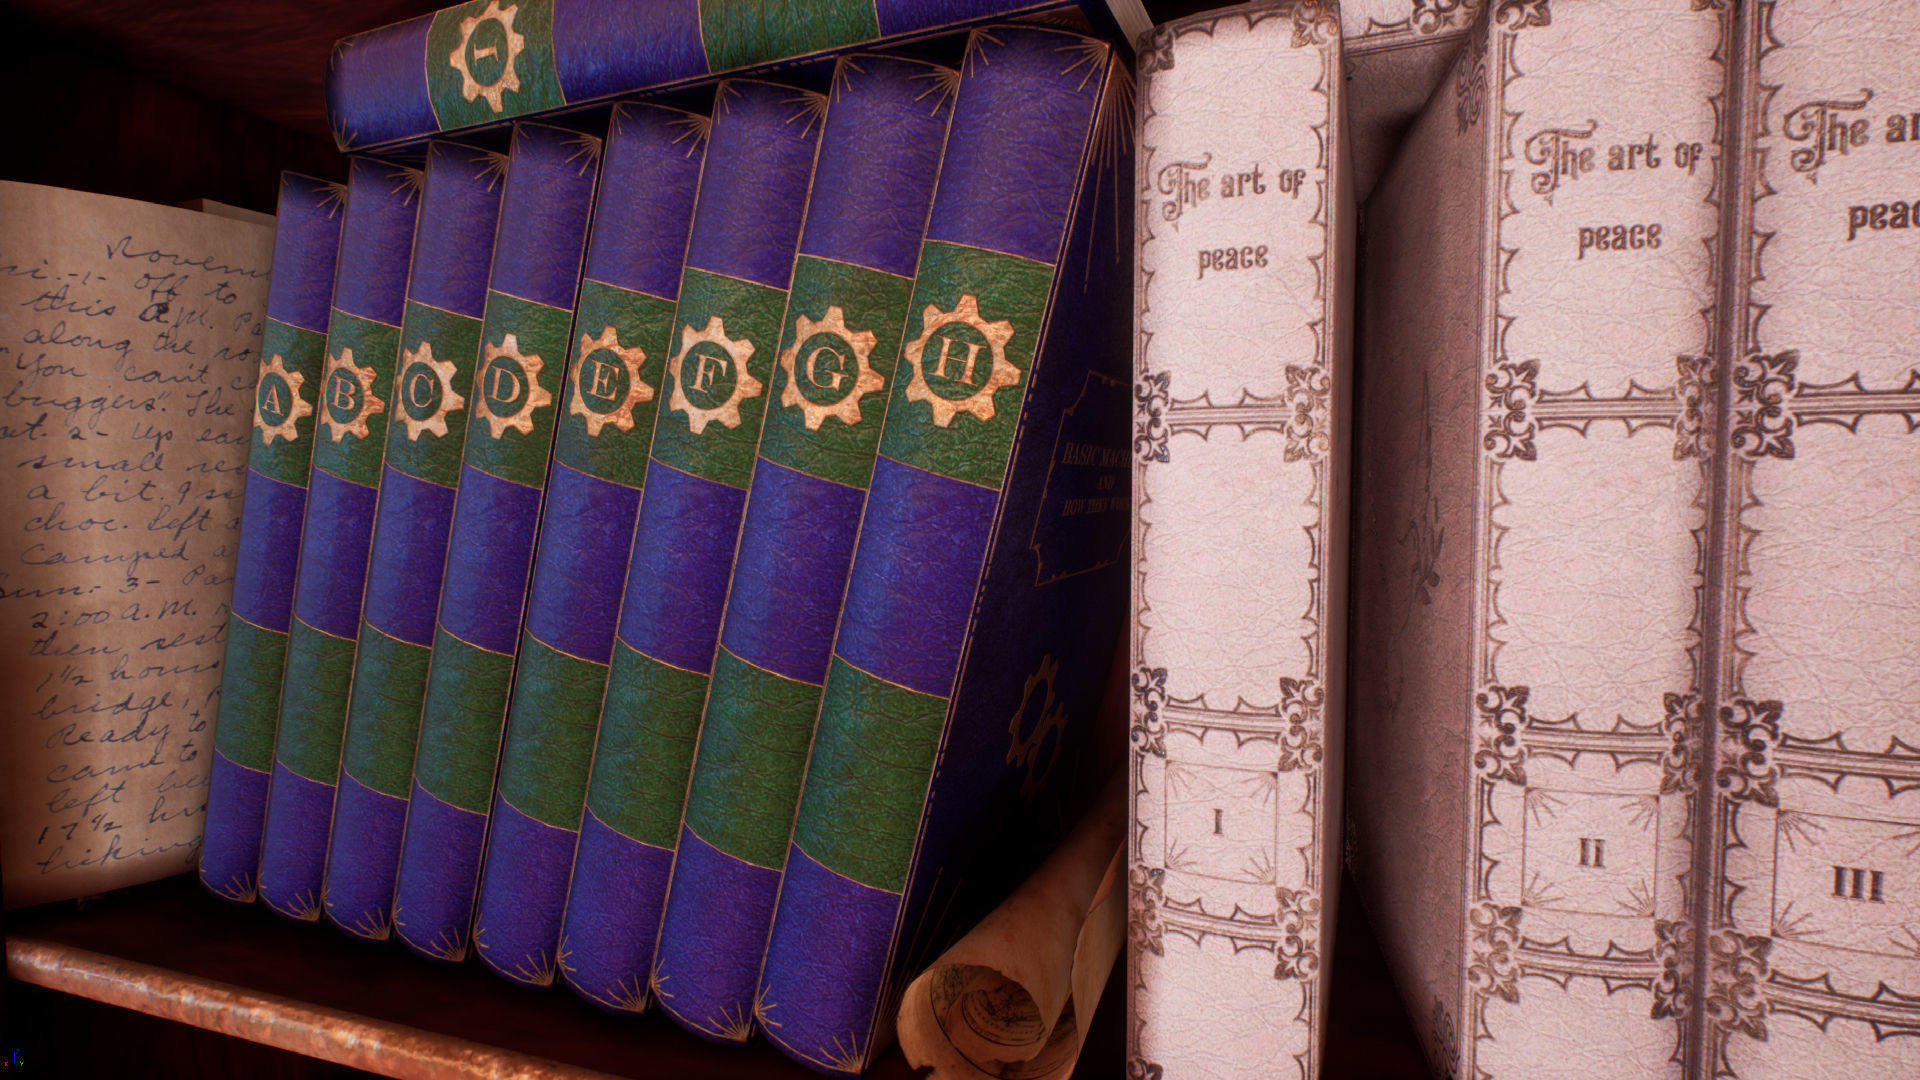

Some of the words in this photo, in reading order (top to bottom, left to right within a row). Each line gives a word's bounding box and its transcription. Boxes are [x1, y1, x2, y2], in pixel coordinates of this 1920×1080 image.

[474, 38, 498, 67] I
[1783, 87, 1874, 180] The
[1524, 118, 1598, 201] The
[1607, 133, 1661, 171] art
[1674, 142, 1703, 176] of
[1157, 152, 1212, 228] The
[1220, 163, 1266, 198] art
[1279, 168, 1306, 200] of
[1577, 223, 1662, 260] peace
[1197, 245, 1268, 280] peace
[20, 284, 116, 317] this
[205, 281, 237, 304] to
[23, 320, 132, 371] along
[928, 335, 987, 387] H
[491, 365, 520, 403] D
[587, 359, 620, 401] E
[688, 352, 727, 394] F
[806, 346, 849, 390] G
[262, 384, 284, 416] A
[330, 375, 355, 410] B
[409, 373, 435, 408] C
[1062, 441, 1100, 466] BASIC
[27, 484, 56, 500] a
[147, 504, 214, 542] left
[46, 712, 170, 750] Ready
[1213, 808, 1224, 836] I
[1579, 837, 1606, 868] II
[1832, 865, 1886, 904] III
